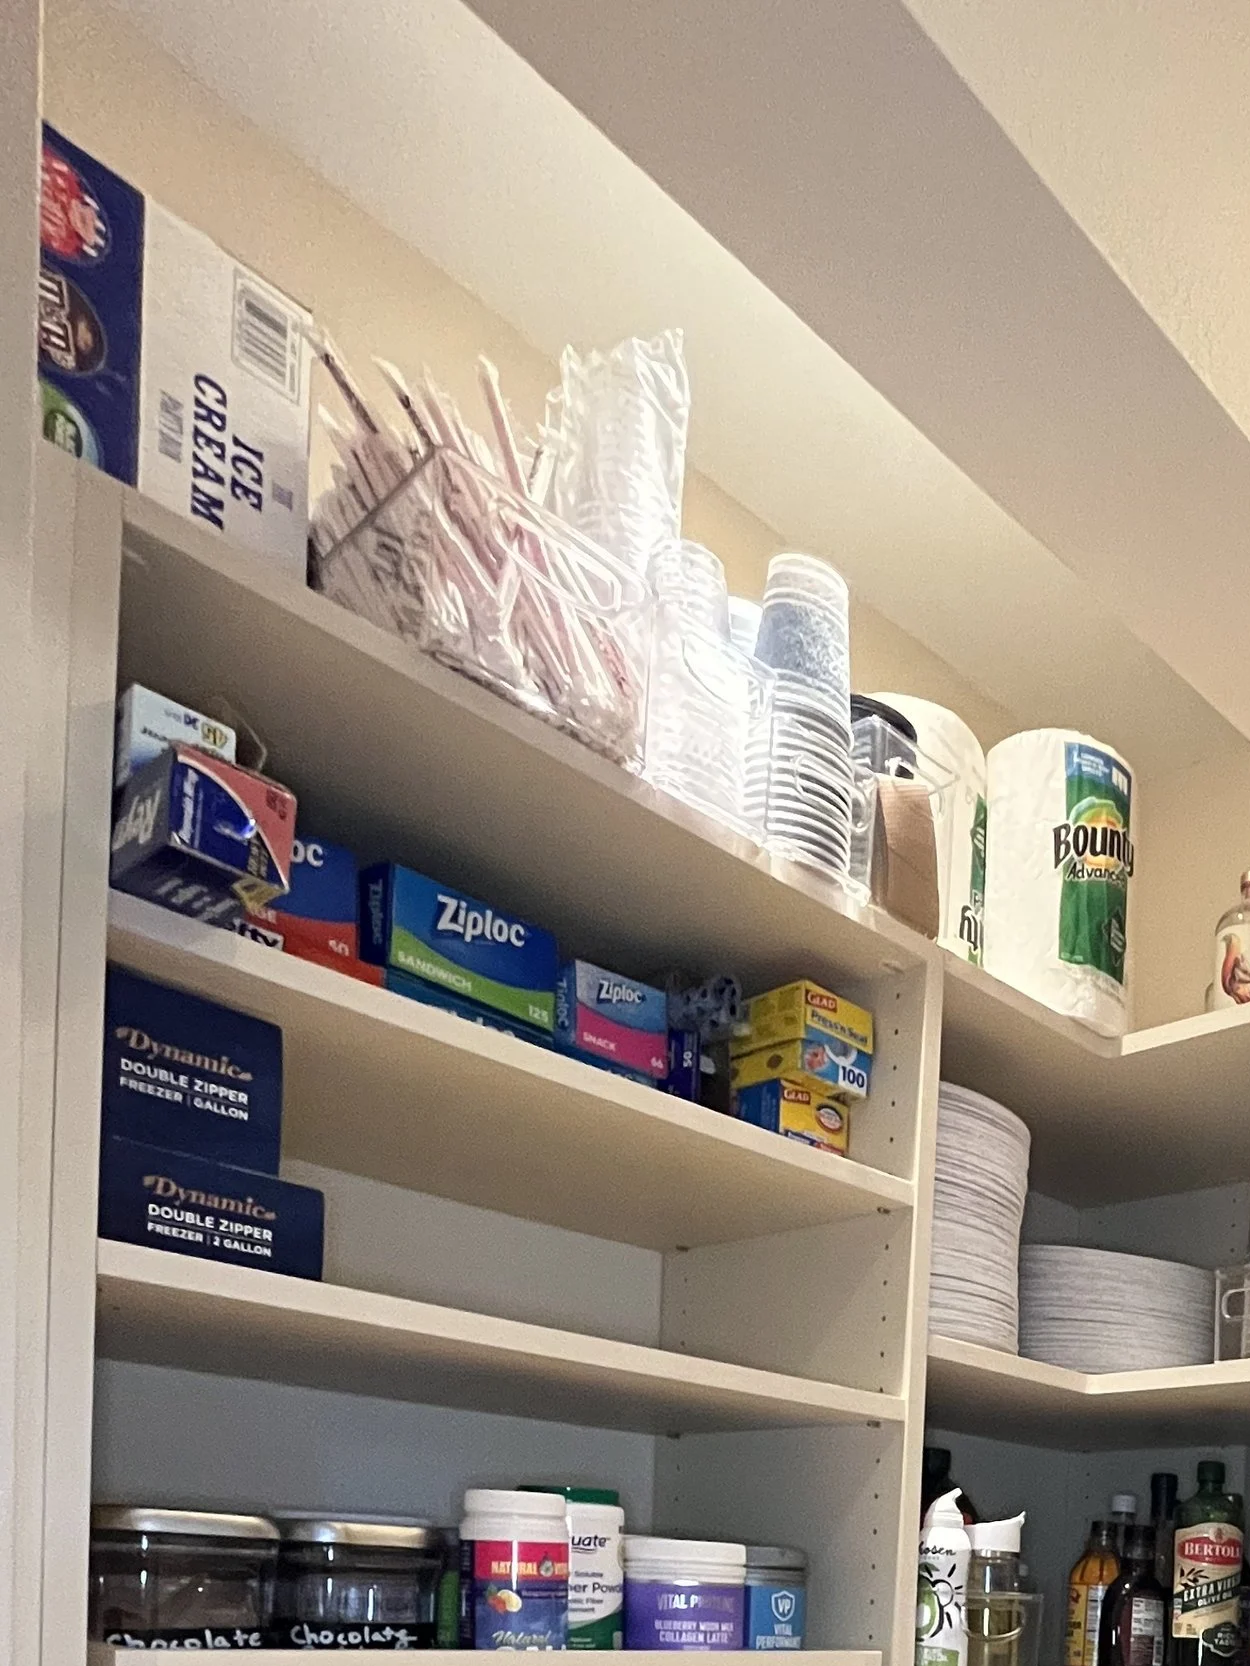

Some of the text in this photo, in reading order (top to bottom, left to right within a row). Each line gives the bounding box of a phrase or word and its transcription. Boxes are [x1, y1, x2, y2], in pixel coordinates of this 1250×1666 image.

[190, 373, 227, 531] CREAM
[230, 434, 264, 512] ICE
[1054, 825, 1134, 877] Bounty
[436, 894, 526, 948] Ziploc
[397, 950, 473, 992] SANDWICH
[597, 979, 645, 1005] Ziploc
[806, 990, 838, 1011] GLAD
[527, 1005, 549, 1024] 125
[129, 1028, 242, 1077] Dynamic
[582, 1032, 616, 1052] SNACK
[121, 1058, 249, 1105] DOUBLE ZIPPER
[840, 1065, 865, 1089] 100
[119, 1077, 249, 1121] FREEZER GALLON
[783, 1088, 810, 1105] GLAD
[155, 1176, 267, 1219] Dynamic
[148, 1203, 272, 1241] DOUBLE ZIPPER
[147, 1223, 272, 1257] FREEZER 2 GALLON
[657, 1594, 688, 1611] VITAL
[1183, 1582, 1215, 1602] EXTRA
[1198, 1593, 1220, 1607] OLIVE
[778, 1599, 791, 1613] VP
[654, 1619, 696, 1631] BLUEBERRY
[659, 1631, 729, 1643] COLLAGEN LATTE
[774, 1624, 792, 1635] VITAL
[492, 1630, 550, 1645] Natural
